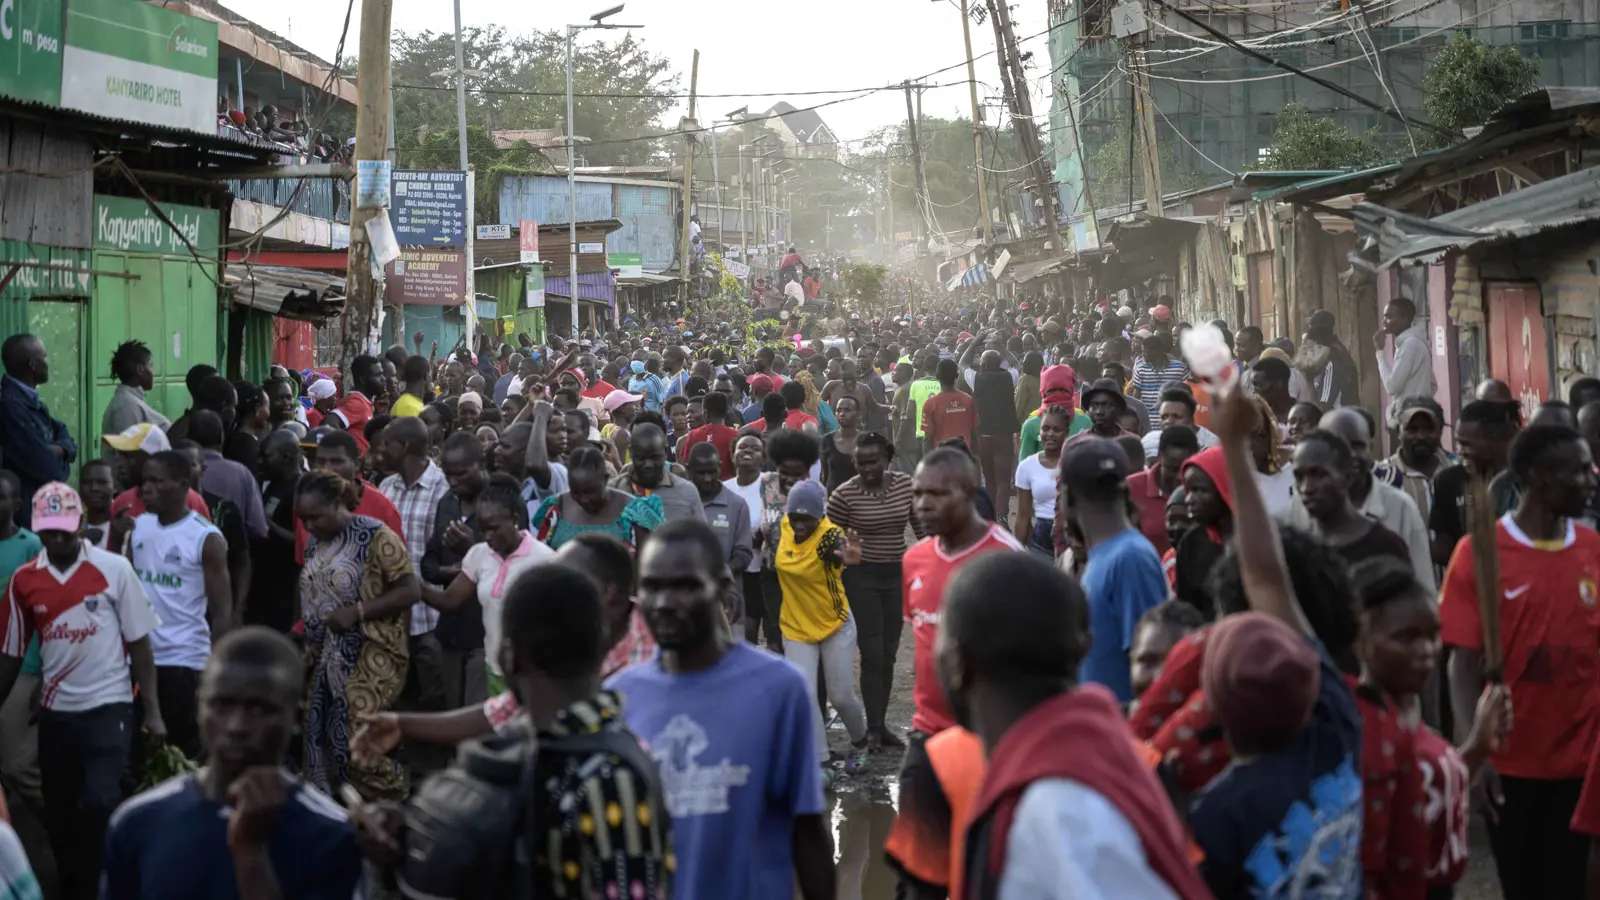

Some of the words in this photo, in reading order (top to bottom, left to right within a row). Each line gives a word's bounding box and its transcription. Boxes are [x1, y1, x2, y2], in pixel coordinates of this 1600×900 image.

[105, 76, 155, 102] KANYARIRO
[156, 86, 182, 107] HOTEL
[392, 172, 428, 180] SEVENTH-DAY
[430, 173, 464, 181] ADVENTIST
[408, 182, 431, 190] CHURCH
[434, 183, 455, 191] KIBERA
[99, 205, 162, 249] Kanyariro
[422, 253, 458, 262] ADVENTIST
[408, 262, 440, 270] ACADEMY
